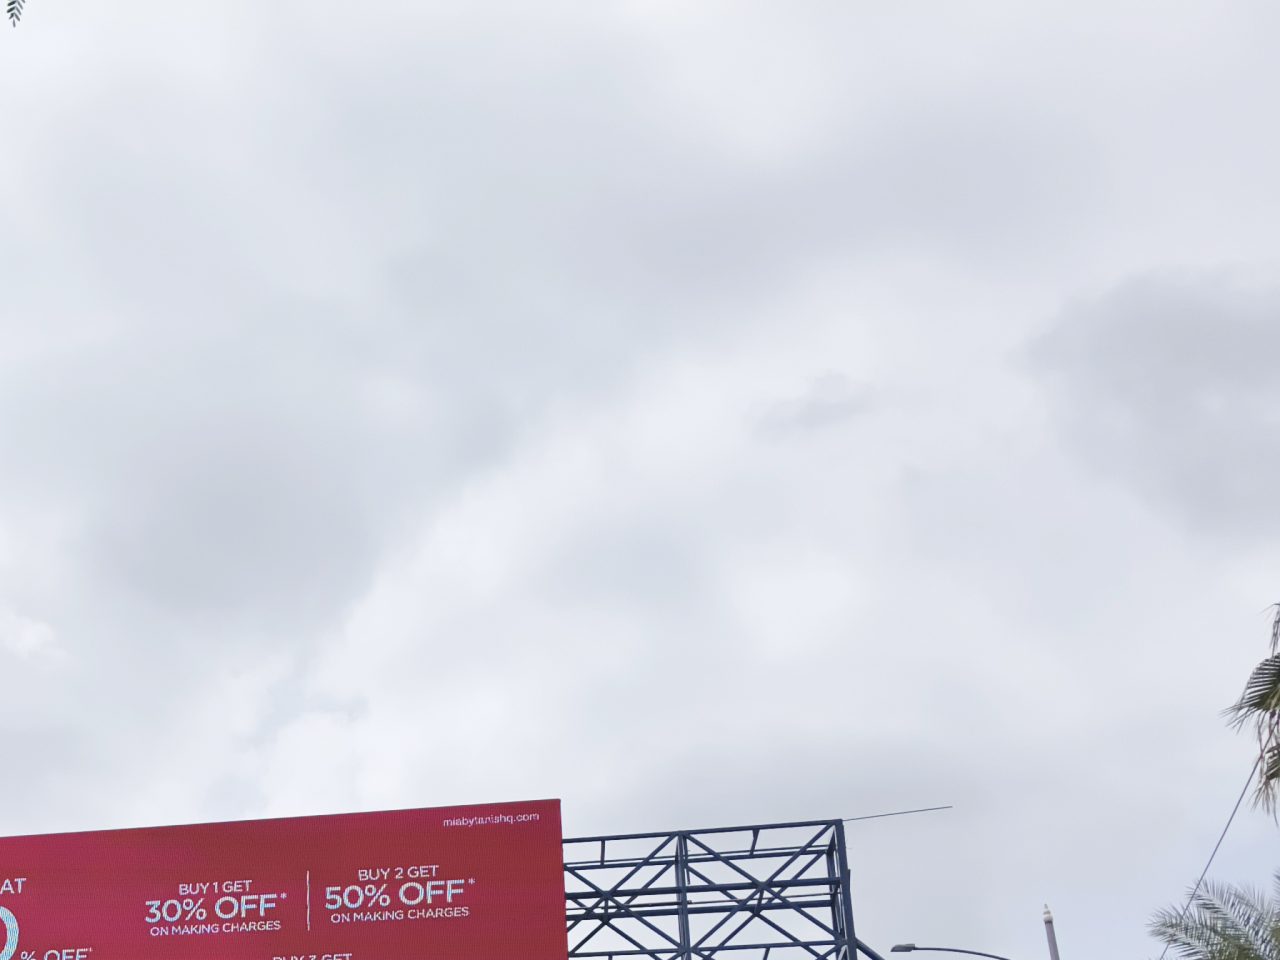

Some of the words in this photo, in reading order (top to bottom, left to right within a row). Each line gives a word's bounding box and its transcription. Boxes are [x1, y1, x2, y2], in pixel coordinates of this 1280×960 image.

[443, 812, 540, 827] miabytanishq.com
[358, 868, 390, 881] BUY
[394, 867, 403, 879] 2
[407, 865, 439, 878] GET
[0, 878, 26, 895] AT
[179, 883, 209, 895] BUY
[213, 882, 219, 893] 1
[222, 880, 252, 893] GET
[325, 884, 391, 910] 50%
[145, 898, 207, 923] 30%
[331, 913, 350, 923] ON
[353, 910, 404, 922] MAKING
[407, 907, 469, 919] CHARGES
[150, 926, 169, 936] ON
[171, 923, 219, 935] MAKING
[222, 920, 281, 933] CHARGES
